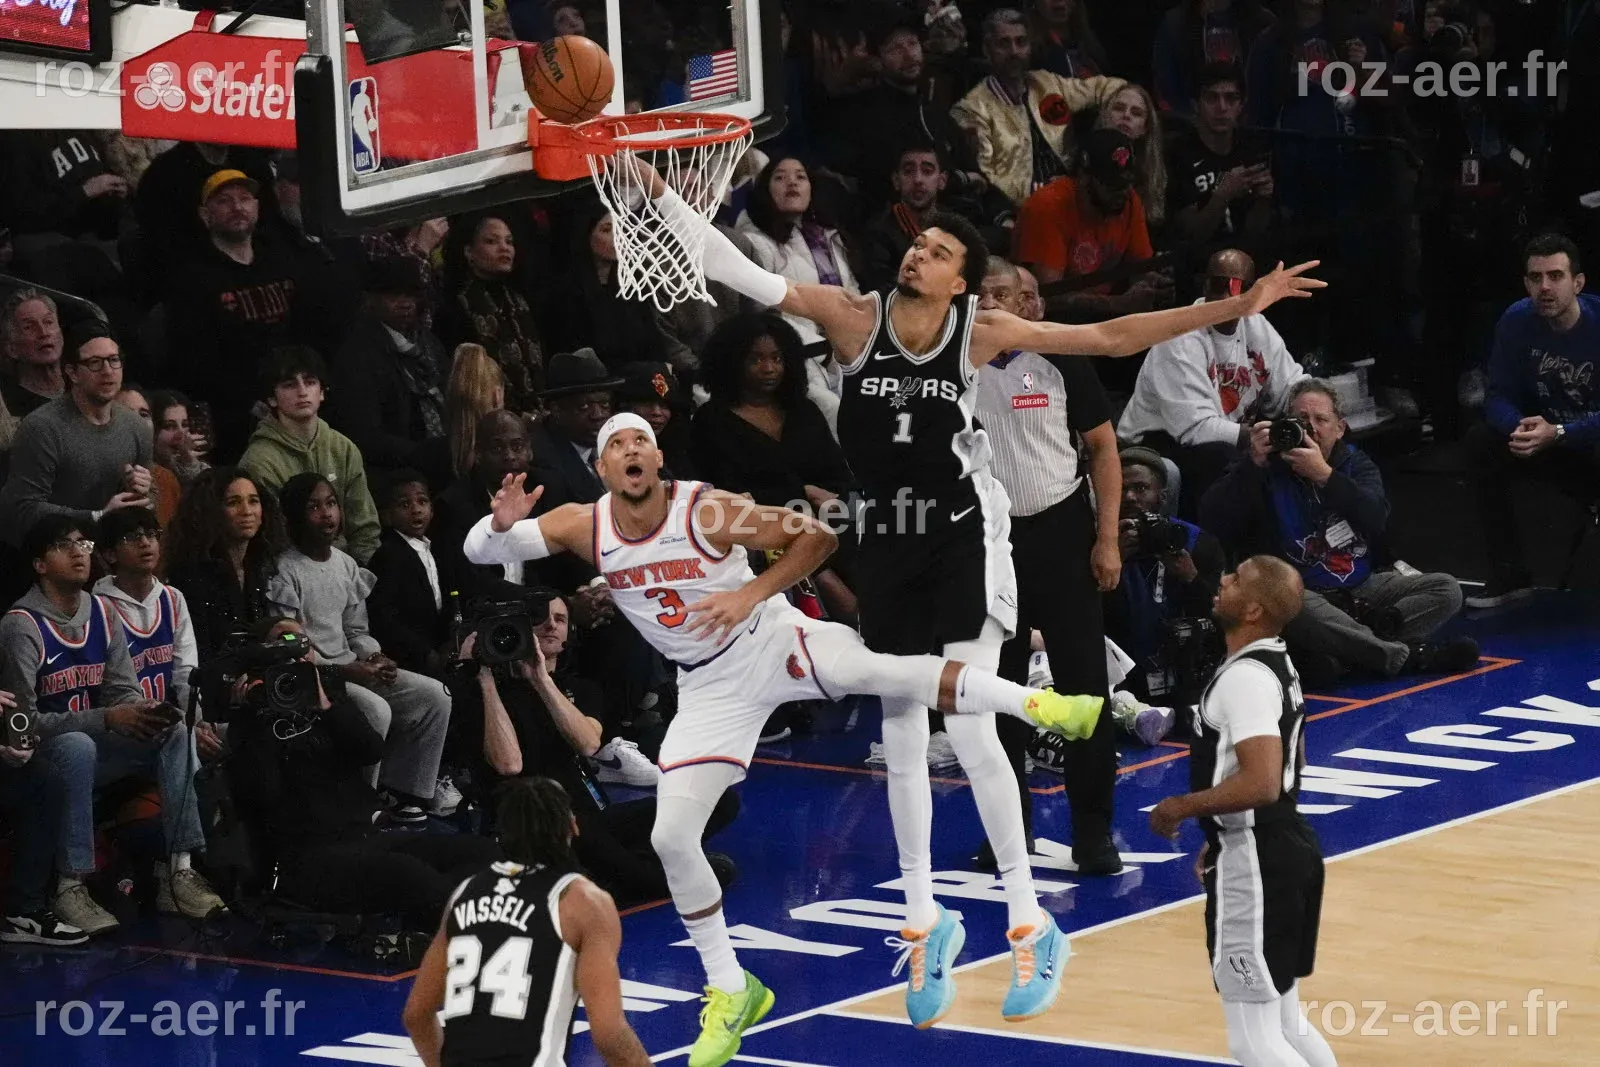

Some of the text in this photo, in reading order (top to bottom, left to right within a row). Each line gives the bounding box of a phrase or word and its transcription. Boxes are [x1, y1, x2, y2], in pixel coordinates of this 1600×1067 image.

[355, 151, 370, 167] NBA
[1012, 395, 1050, 408] Emirates
[892, 412, 914, 444] 1
[645, 557, 706, 584] YORK
[644, 587, 689, 629] 3
[143, 644, 173, 665] YOR
[41, 662, 106, 697] NEW YOR
[140, 672, 166, 703] 11
[454, 895, 536, 932] VASSELL
[444, 934, 533, 1020] 24
